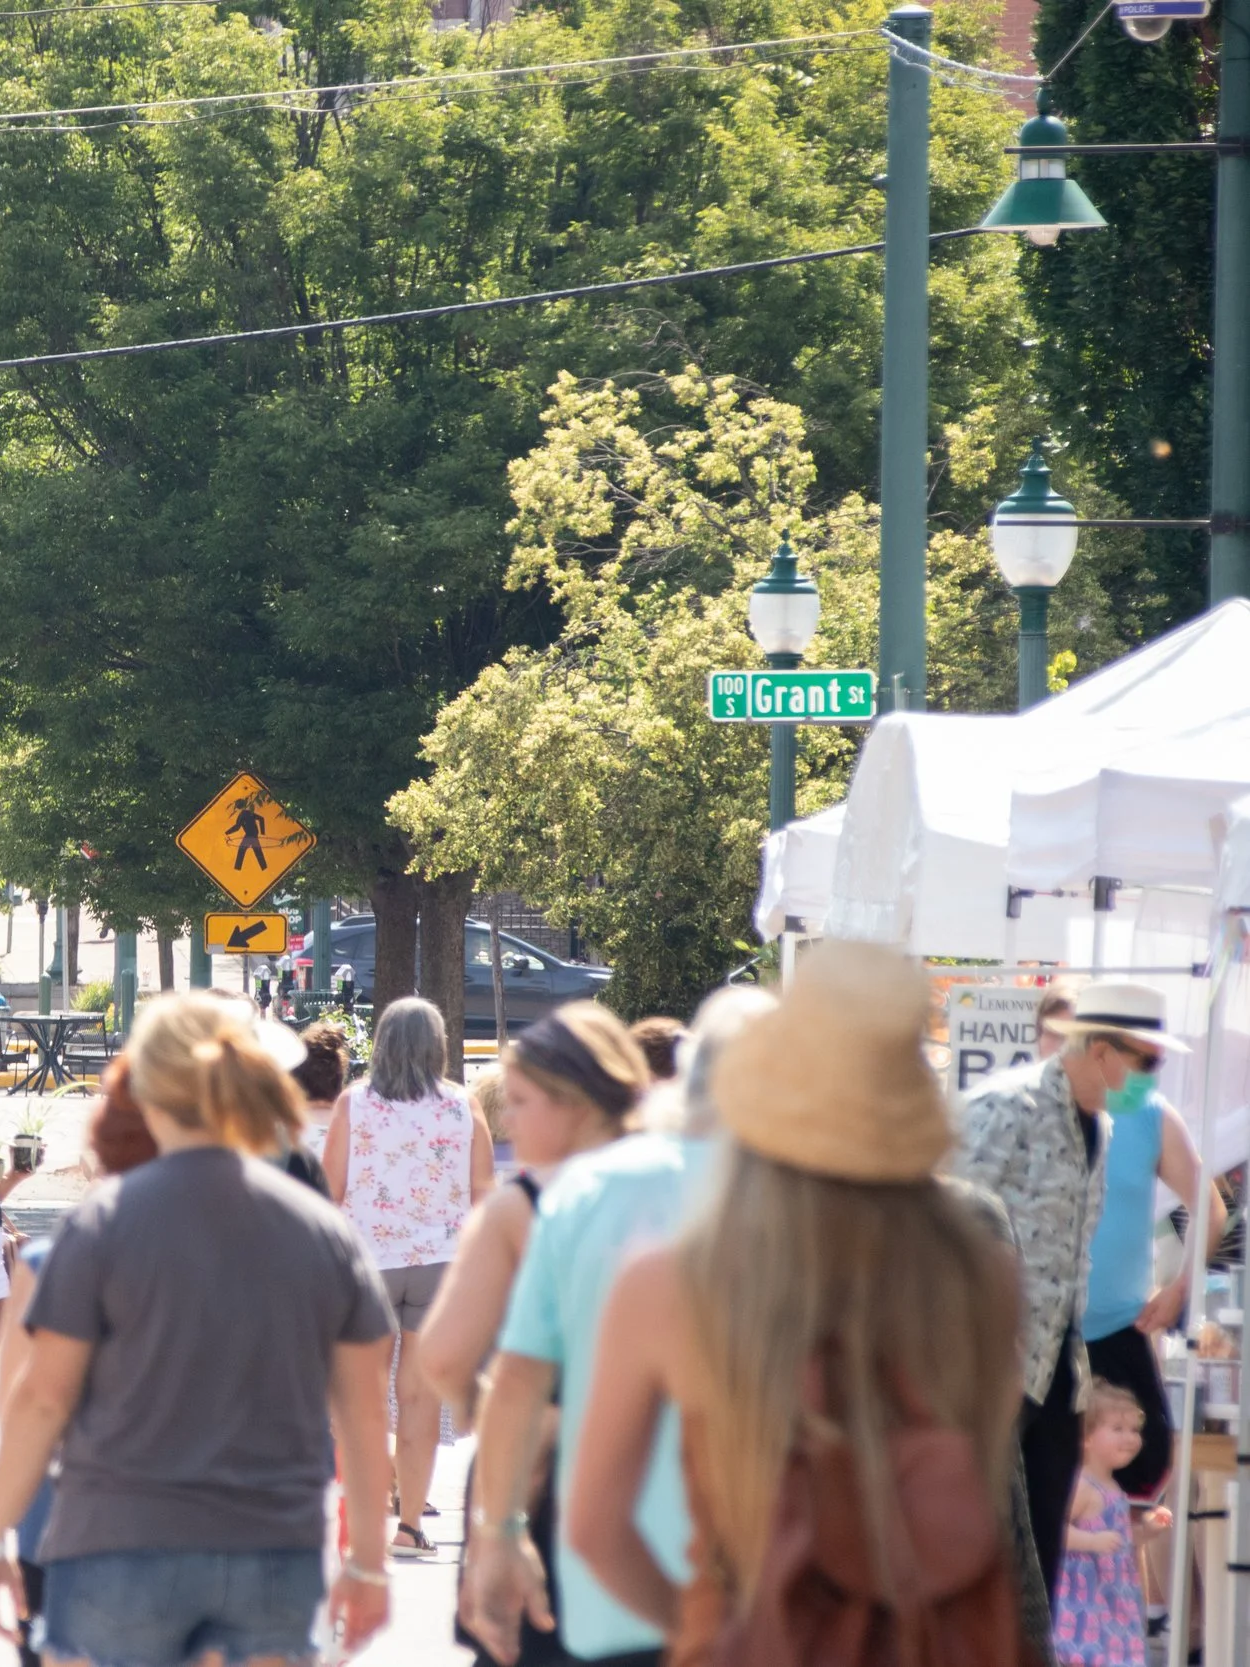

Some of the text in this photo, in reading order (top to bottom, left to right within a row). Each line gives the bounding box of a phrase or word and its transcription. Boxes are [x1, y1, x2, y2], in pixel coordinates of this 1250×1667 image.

[716, 676, 744, 695] 100
[755, 678, 866, 713] Grant St
[725, 697, 736, 716] S
